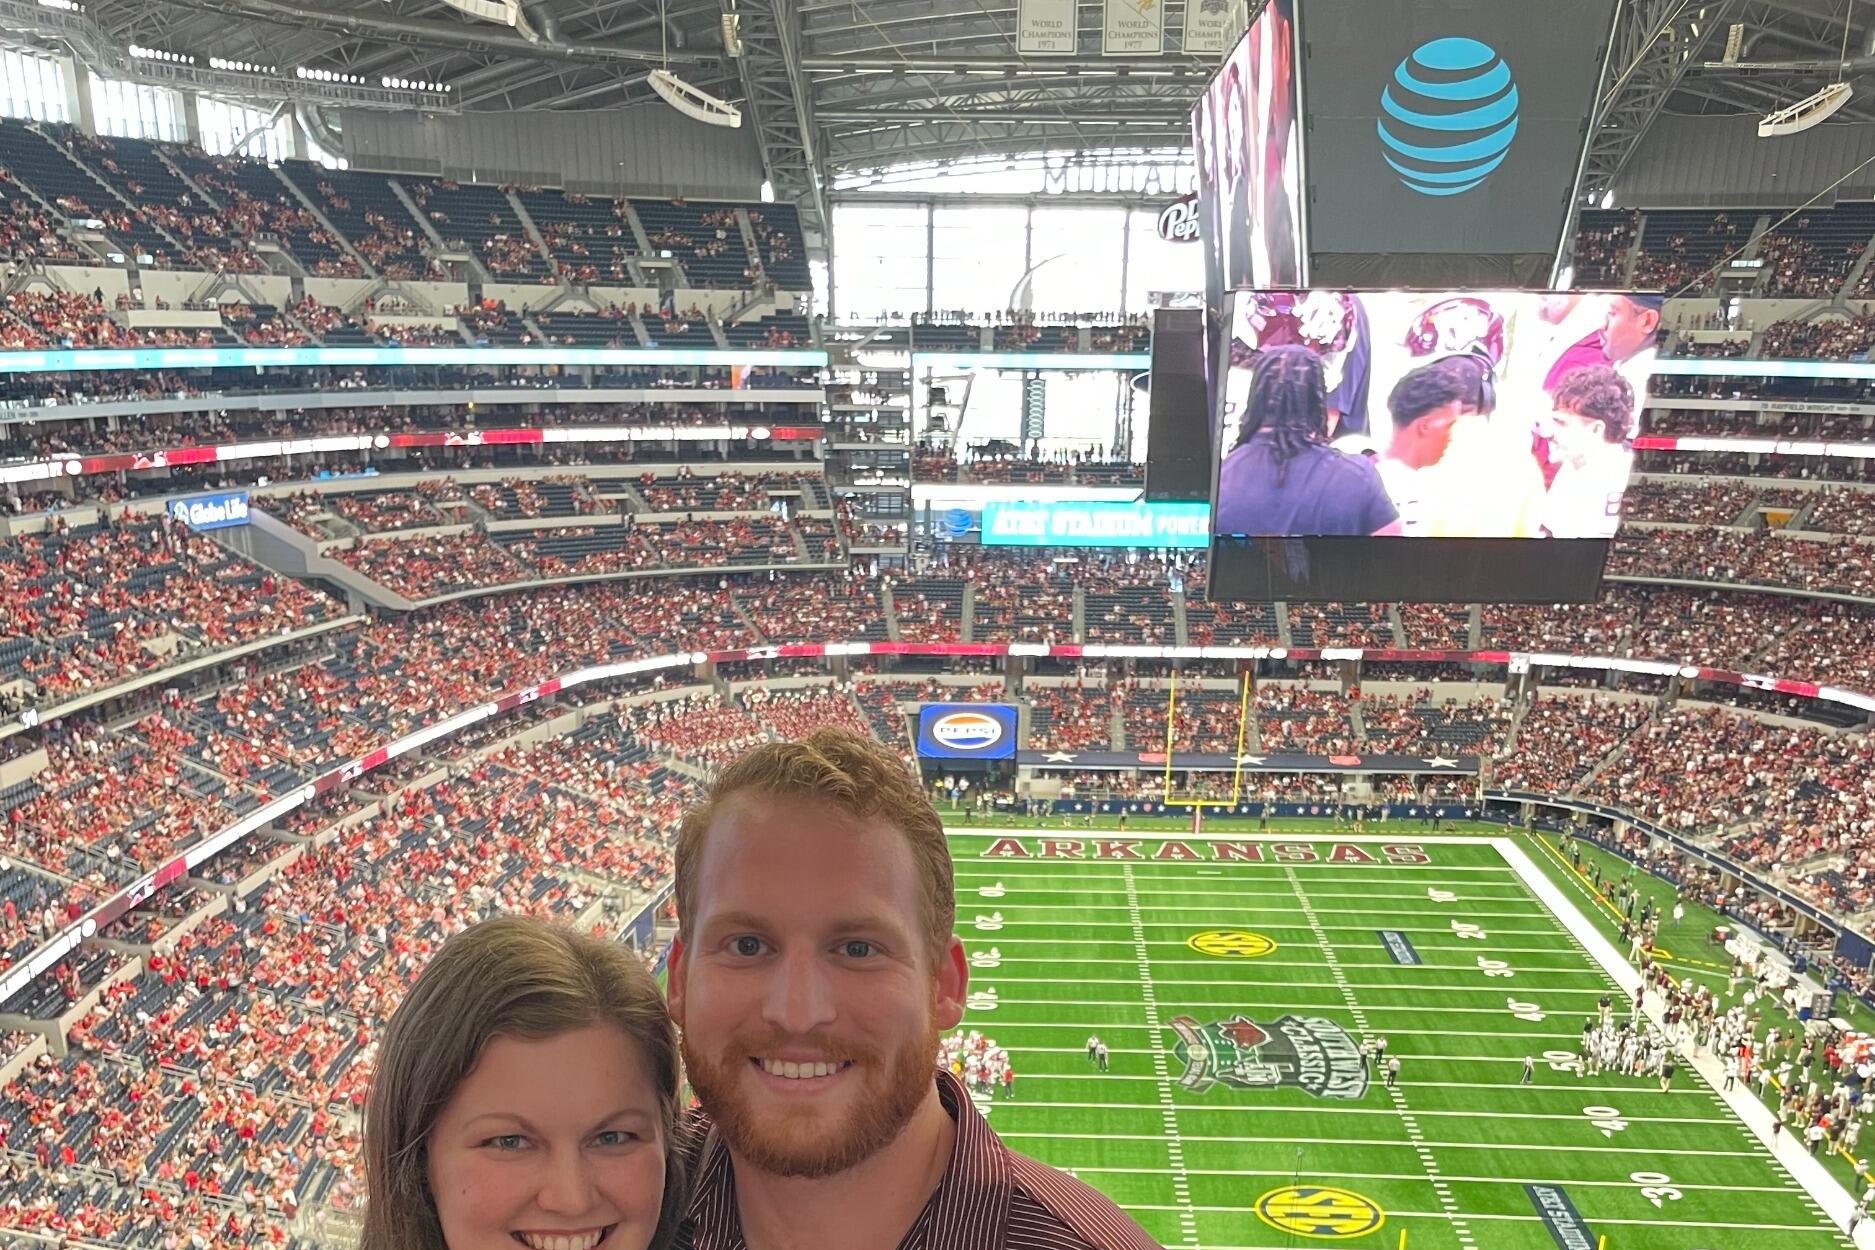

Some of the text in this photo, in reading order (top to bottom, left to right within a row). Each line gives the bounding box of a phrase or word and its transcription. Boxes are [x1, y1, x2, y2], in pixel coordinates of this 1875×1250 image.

[1032, 20, 1062, 28] WORLD
[1118, 20, 1149, 29] WORLD
[1199, 20, 1222, 28] WORL
[1022, 30, 1072, 38] CHAMPIONS
[1108, 30, 1158, 39] CHAMPIONS
[940, 726, 995, 735] PEPSI
[979, 838, 1432, 864] ARKANSAS
[1280, 1025, 1325, 1083] CLASSIC
[1290, 1016, 1366, 1098] SOUTHWEST
[1583, 1106, 1629, 1131] 40
[1630, 1171, 1683, 1201] 30
